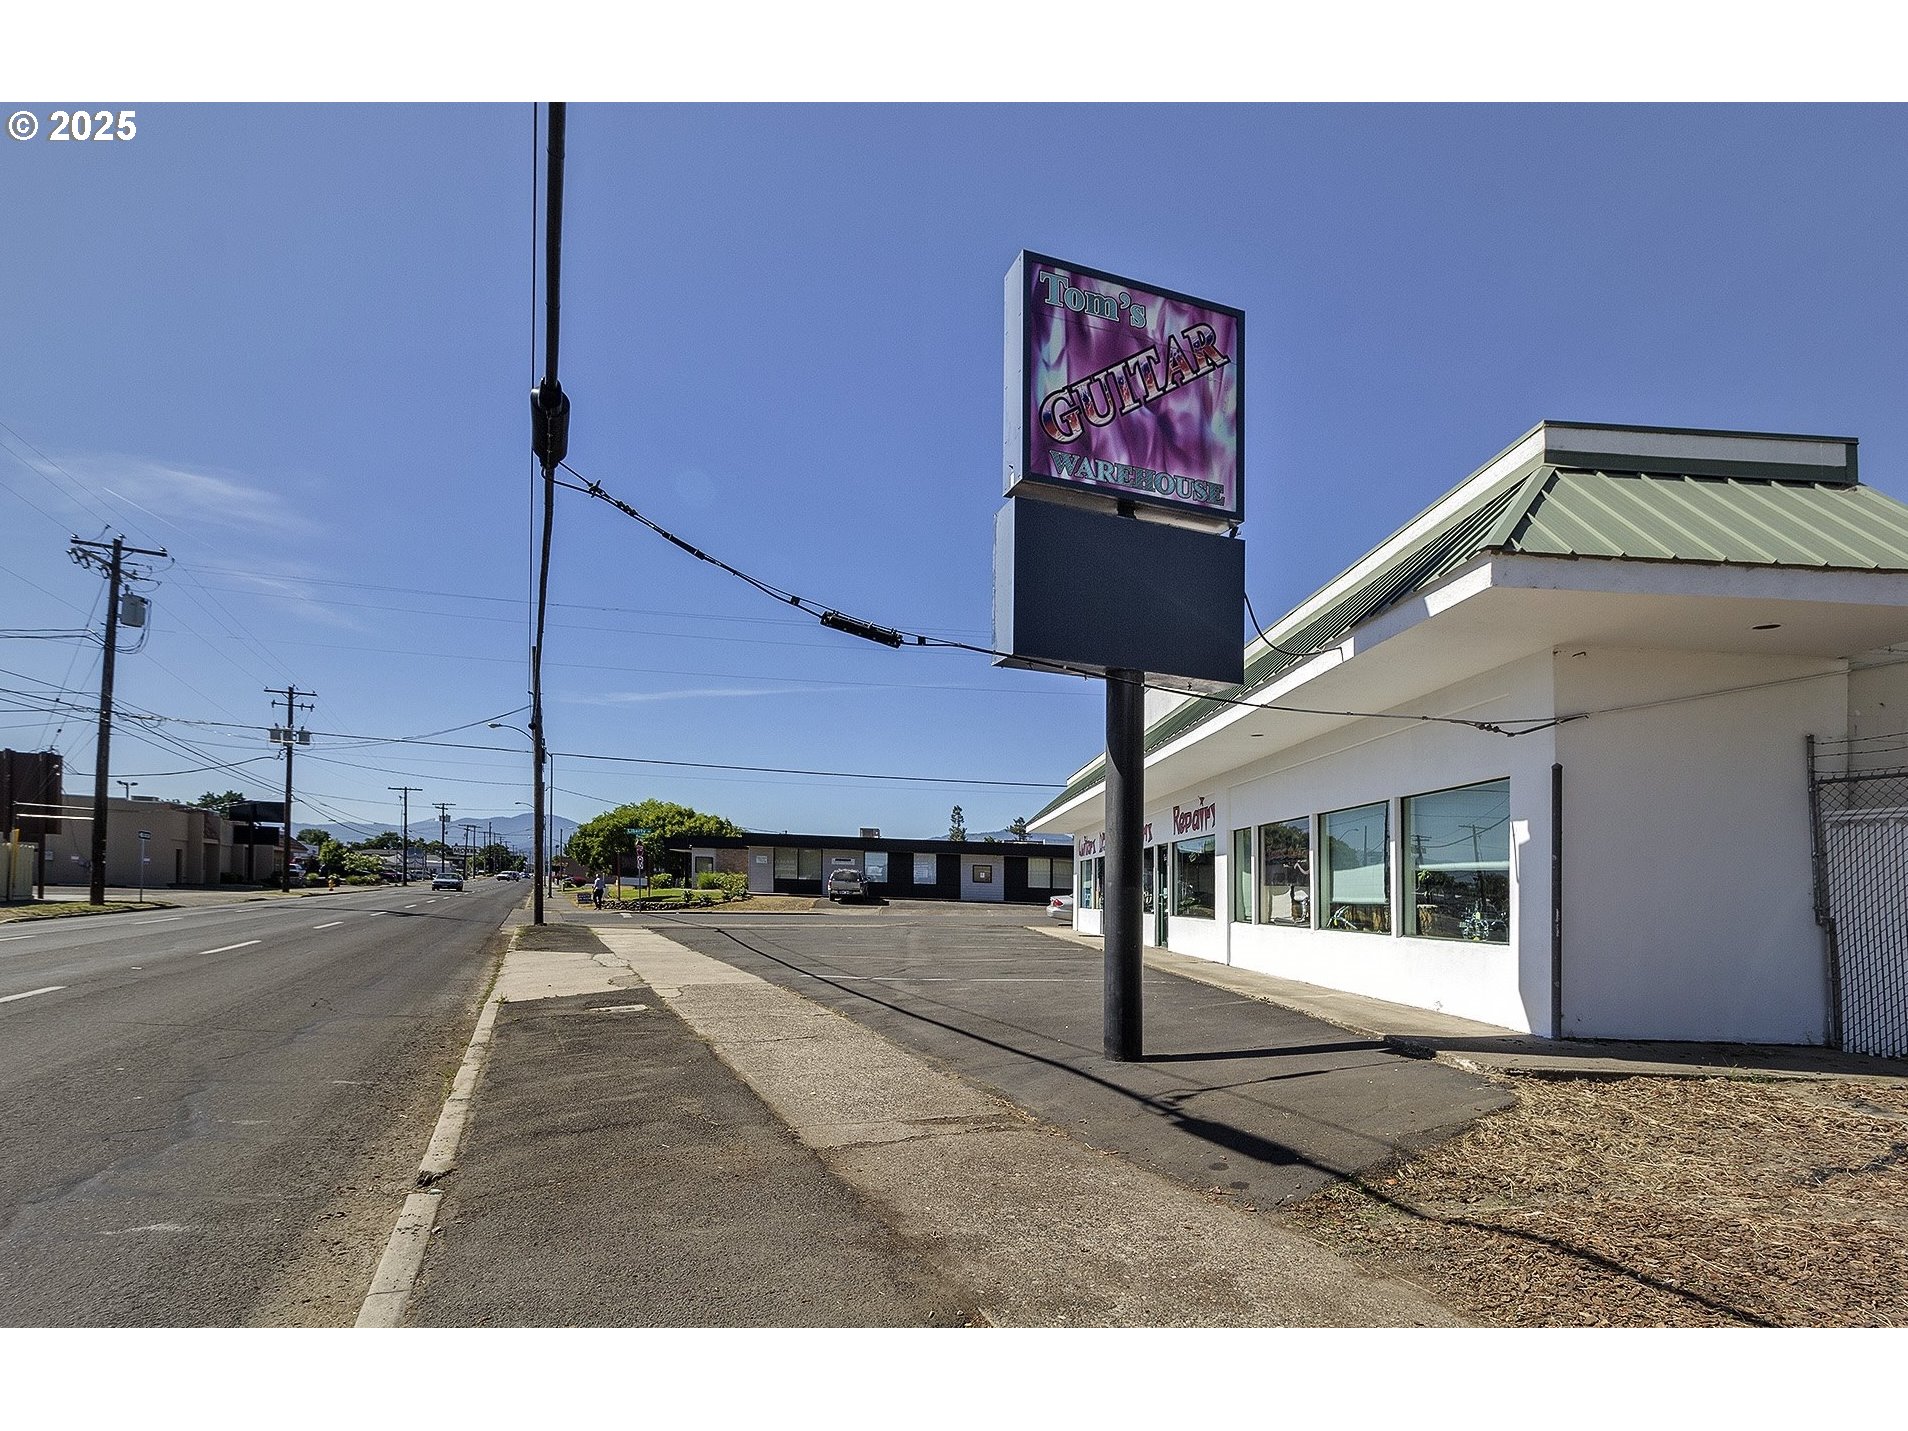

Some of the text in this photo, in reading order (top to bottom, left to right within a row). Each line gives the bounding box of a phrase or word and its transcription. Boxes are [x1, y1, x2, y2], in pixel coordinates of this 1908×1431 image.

[1039, 270, 1147, 329] Tom's
[1039, 323, 1231, 444] GUITAR
[1049, 449, 1225, 506] WAREHOUSE
